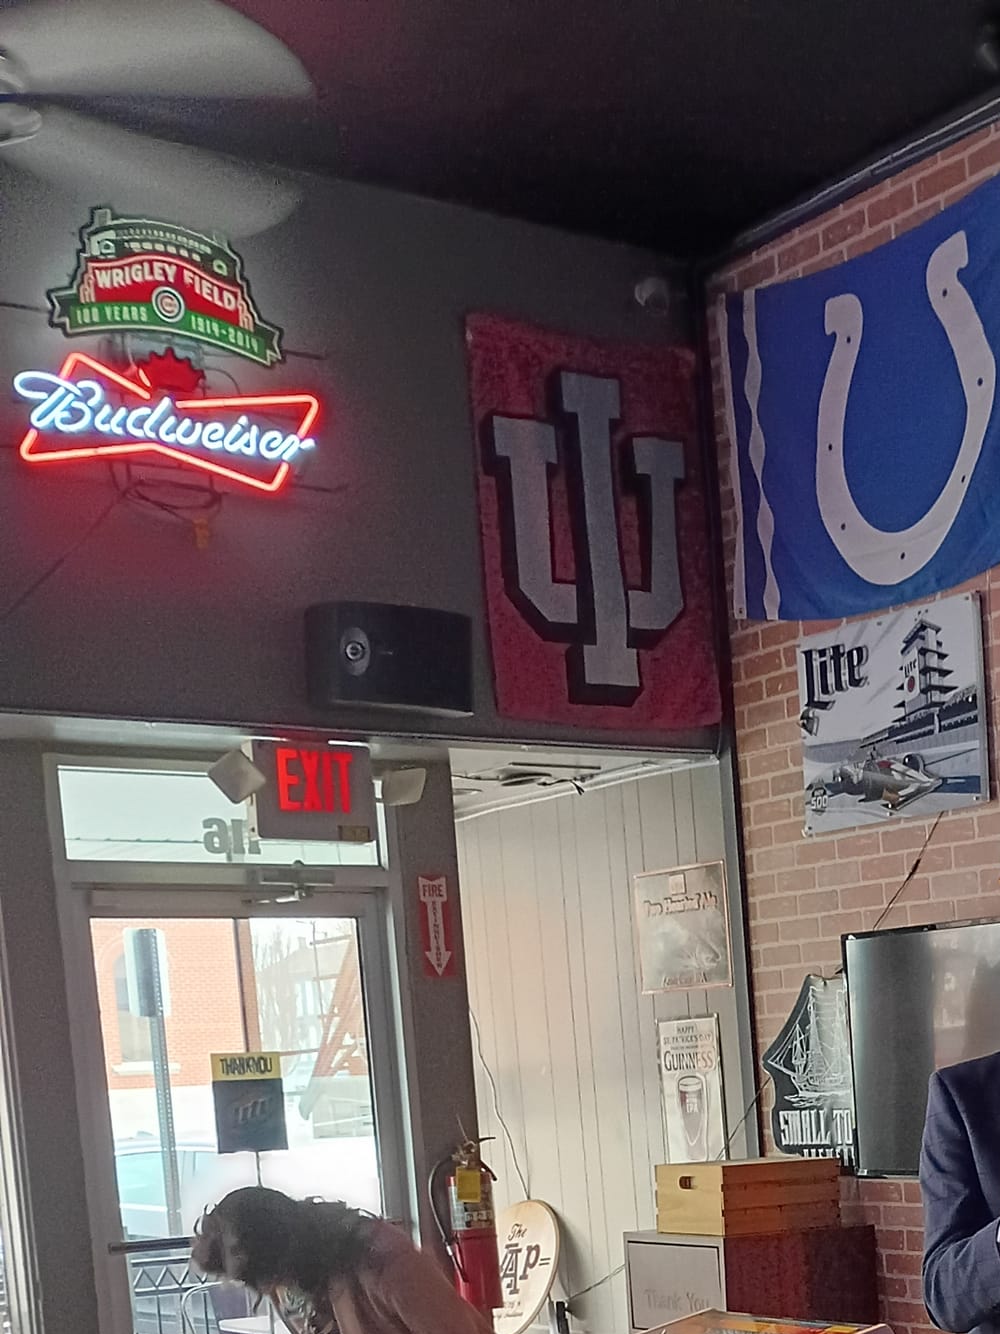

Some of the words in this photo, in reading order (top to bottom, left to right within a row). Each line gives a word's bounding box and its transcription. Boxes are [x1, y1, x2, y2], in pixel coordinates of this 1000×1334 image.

[95, 262, 178, 289] WRIGLEY
[184, 271, 237, 311] FIELD
[76, 306, 100, 325] 100
[105, 304, 149, 323] YEARS
[13, 371, 316, 461] Budweiser
[801, 644, 869, 710] Lite
[276, 747, 353, 813] EXIT
[811, 795, 829, 809] 500
[422, 884, 444, 897] FIRE
[663, 1050, 714, 1072] GUINNESS
[779, 1109, 831, 1146] SMALL
[508, 1223, 528, 1242] The
